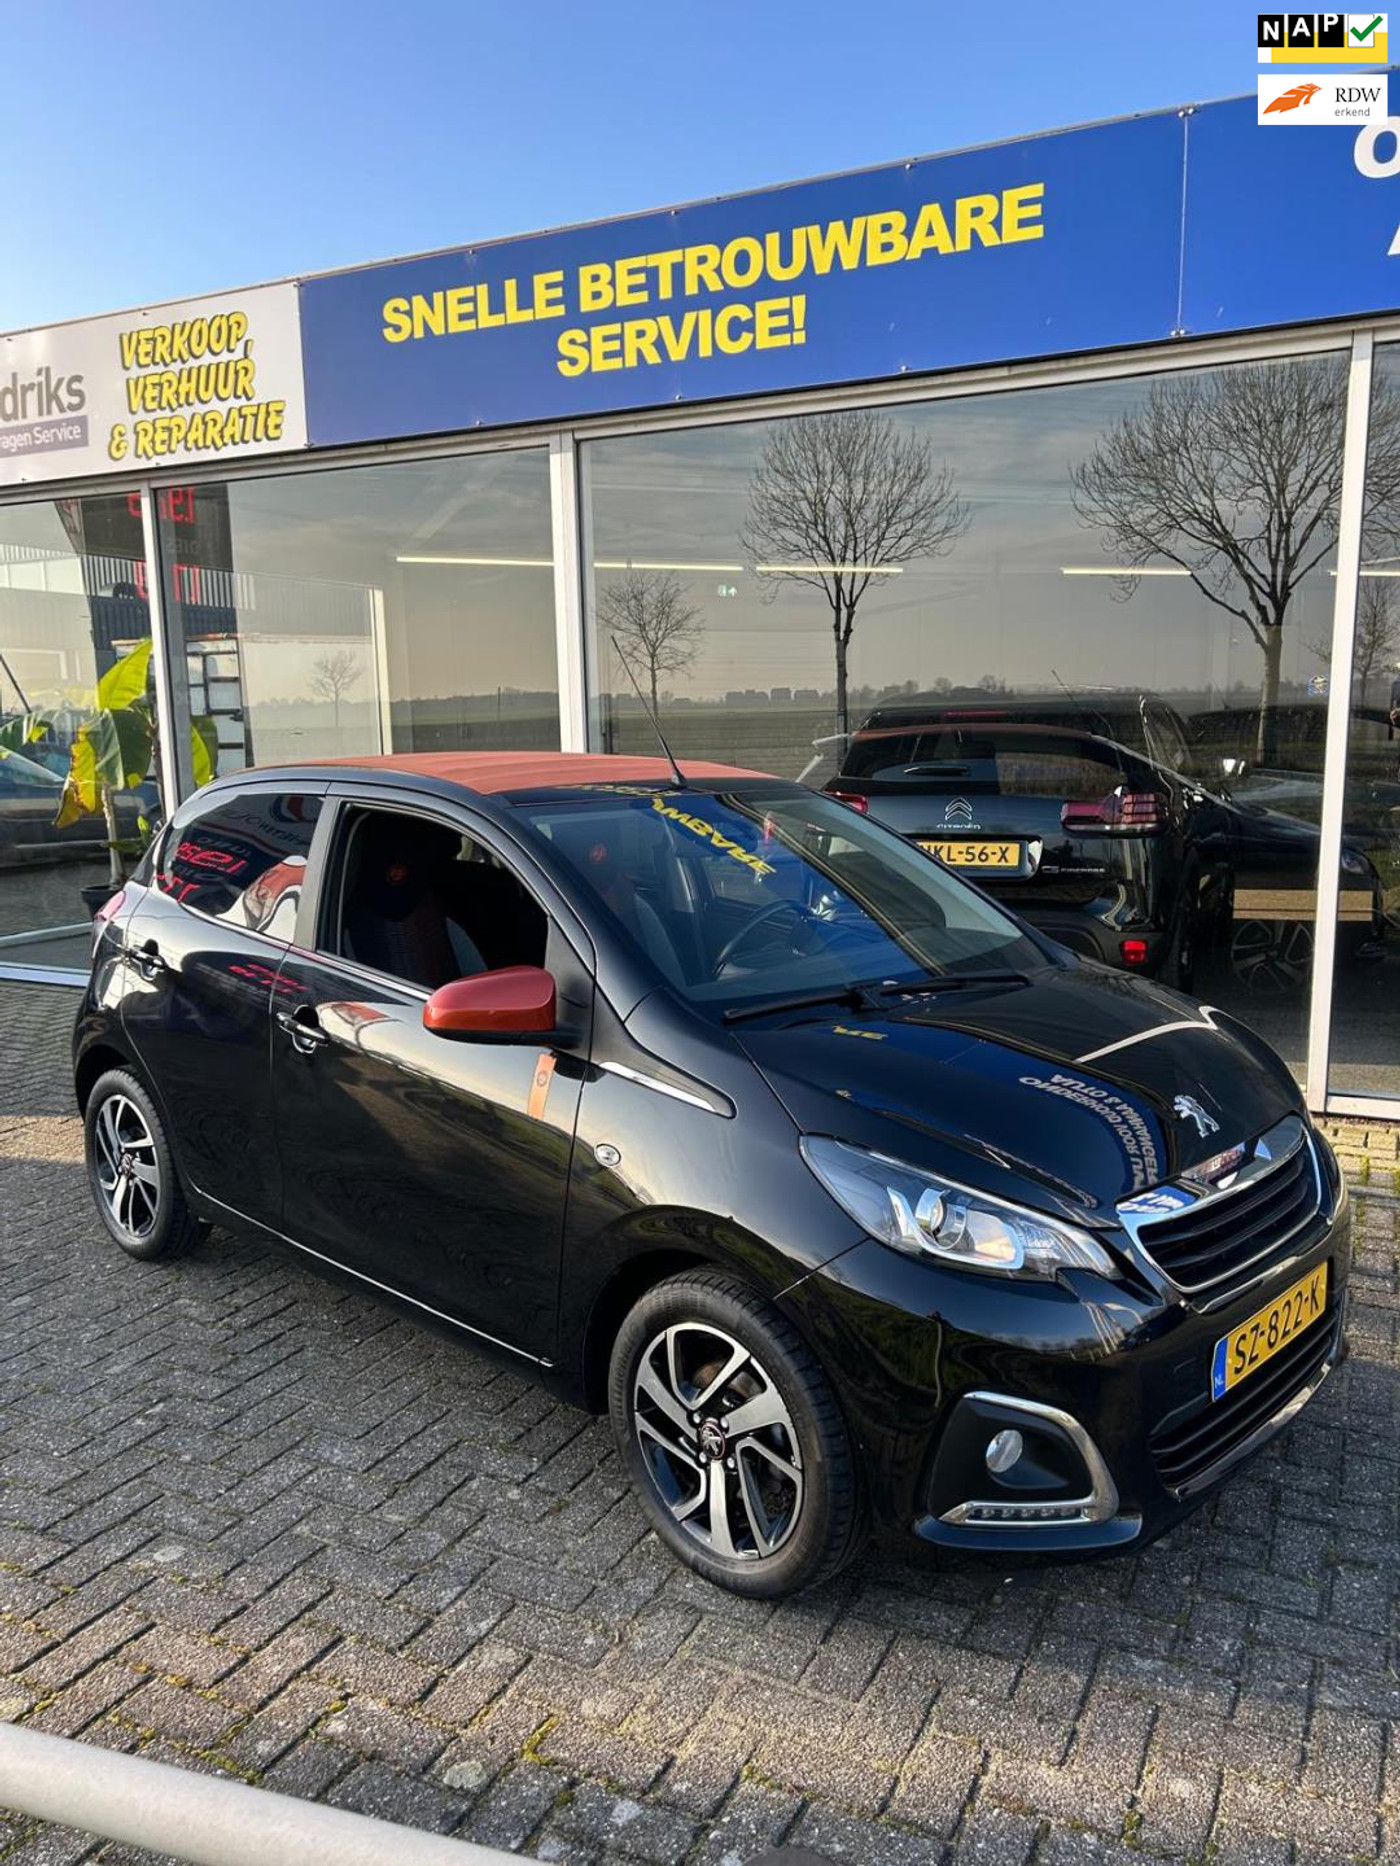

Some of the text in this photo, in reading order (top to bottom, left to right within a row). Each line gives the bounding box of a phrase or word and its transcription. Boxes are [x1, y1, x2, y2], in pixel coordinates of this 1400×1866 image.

[382, 182, 1045, 344] SNELLE BETROUWBARE
[119, 311, 254, 370] VERKOOP,
[556, 295, 807, 378] SERVICE!
[0, 366, 86, 422] driks
[126, 358, 255, 415] VERHUUR
[33, 422, 82, 445] Service
[108, 400, 286, 460] & REPARATIE
[1234, 1275, 1320, 1375] SZ-822-K
